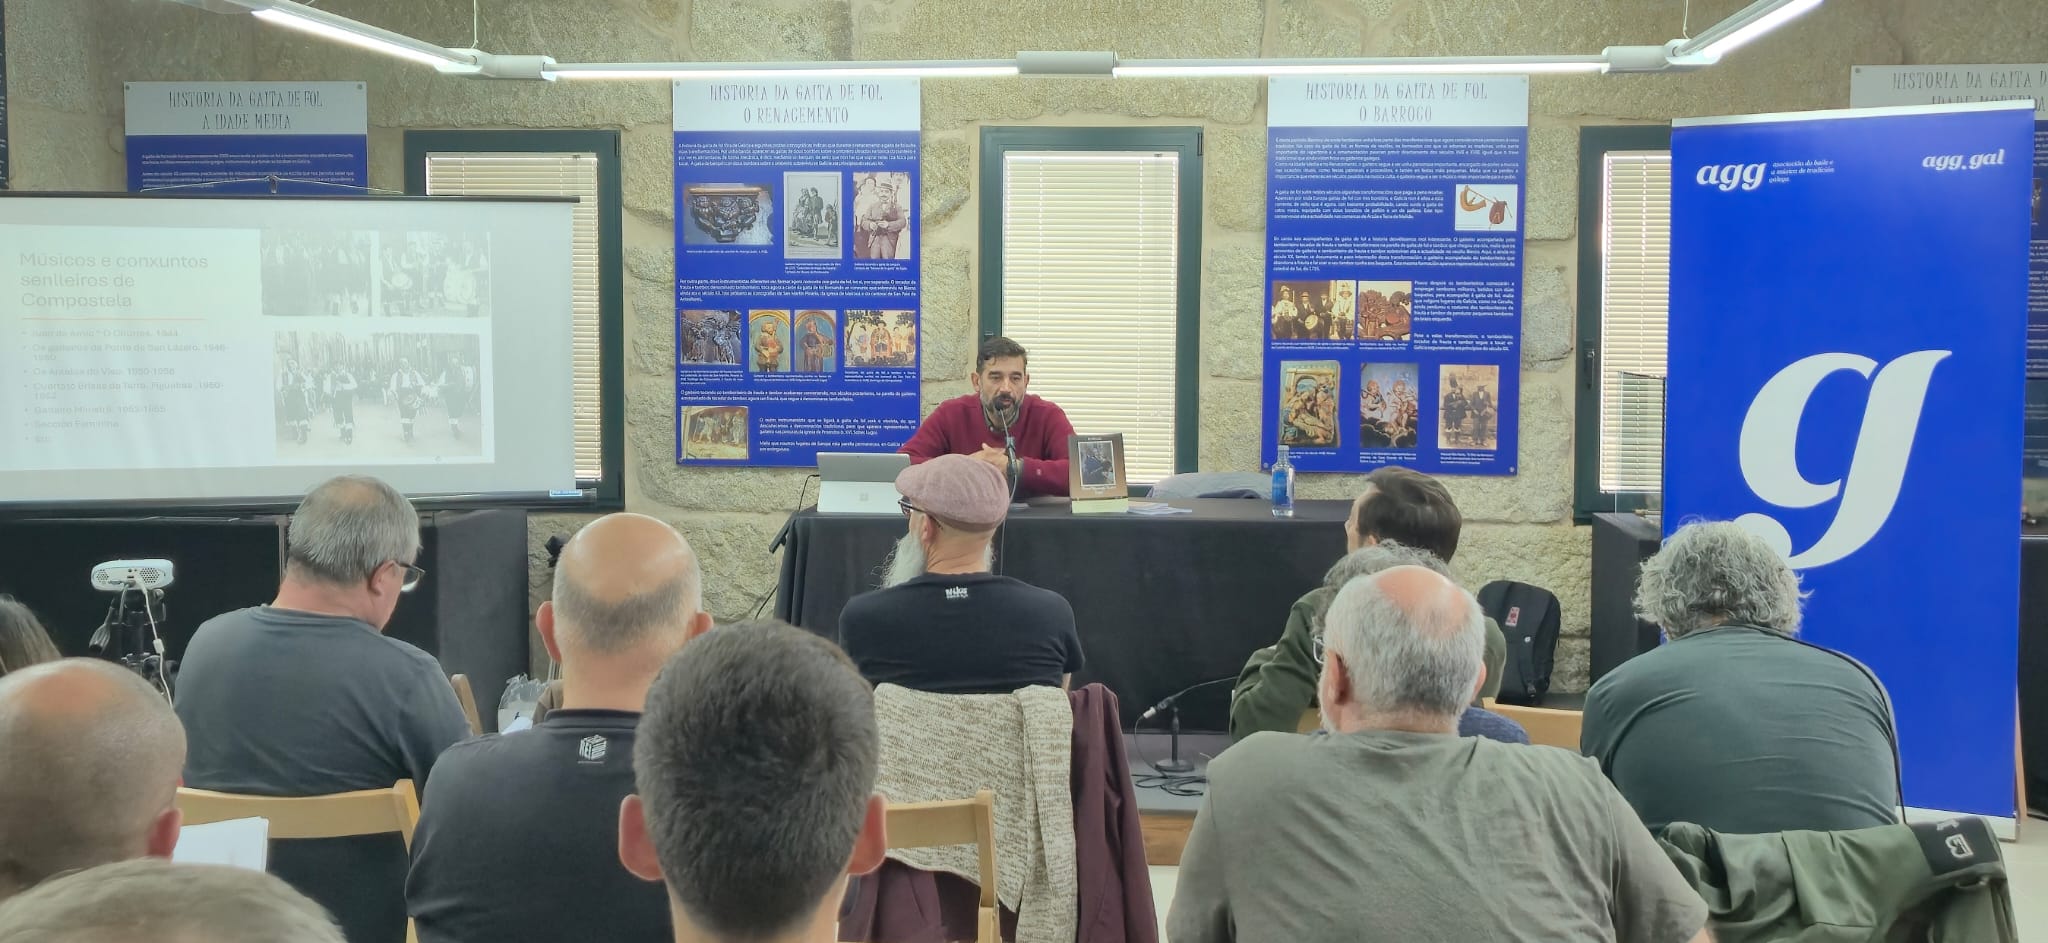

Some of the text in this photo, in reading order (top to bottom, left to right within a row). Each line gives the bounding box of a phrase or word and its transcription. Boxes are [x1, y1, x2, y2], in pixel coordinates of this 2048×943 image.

[1892, 71, 1959, 89] HISTORIA
[1966, 71, 1983, 89] DA
[1990, 71, 2032, 89] GAITA
[169, 90, 323, 107] HISTORIA DA GAITA DE FOL
[709, 84, 883, 101] HISTORIA DA GAITA DE FOL
[1306, 82, 1488, 100] HISTORIA DA GAITA DE FOL
[202, 114, 292, 130] A IDADE MEDIA
[743, 107, 751, 123] O
[1359, 105, 1367, 122] O
[1696, 161, 1767, 191] agg
[20, 252, 208, 269] Músicos e conxuntos
[20, 273, 135, 287] senlleiros de
[21, 292, 132, 309] Compostela
